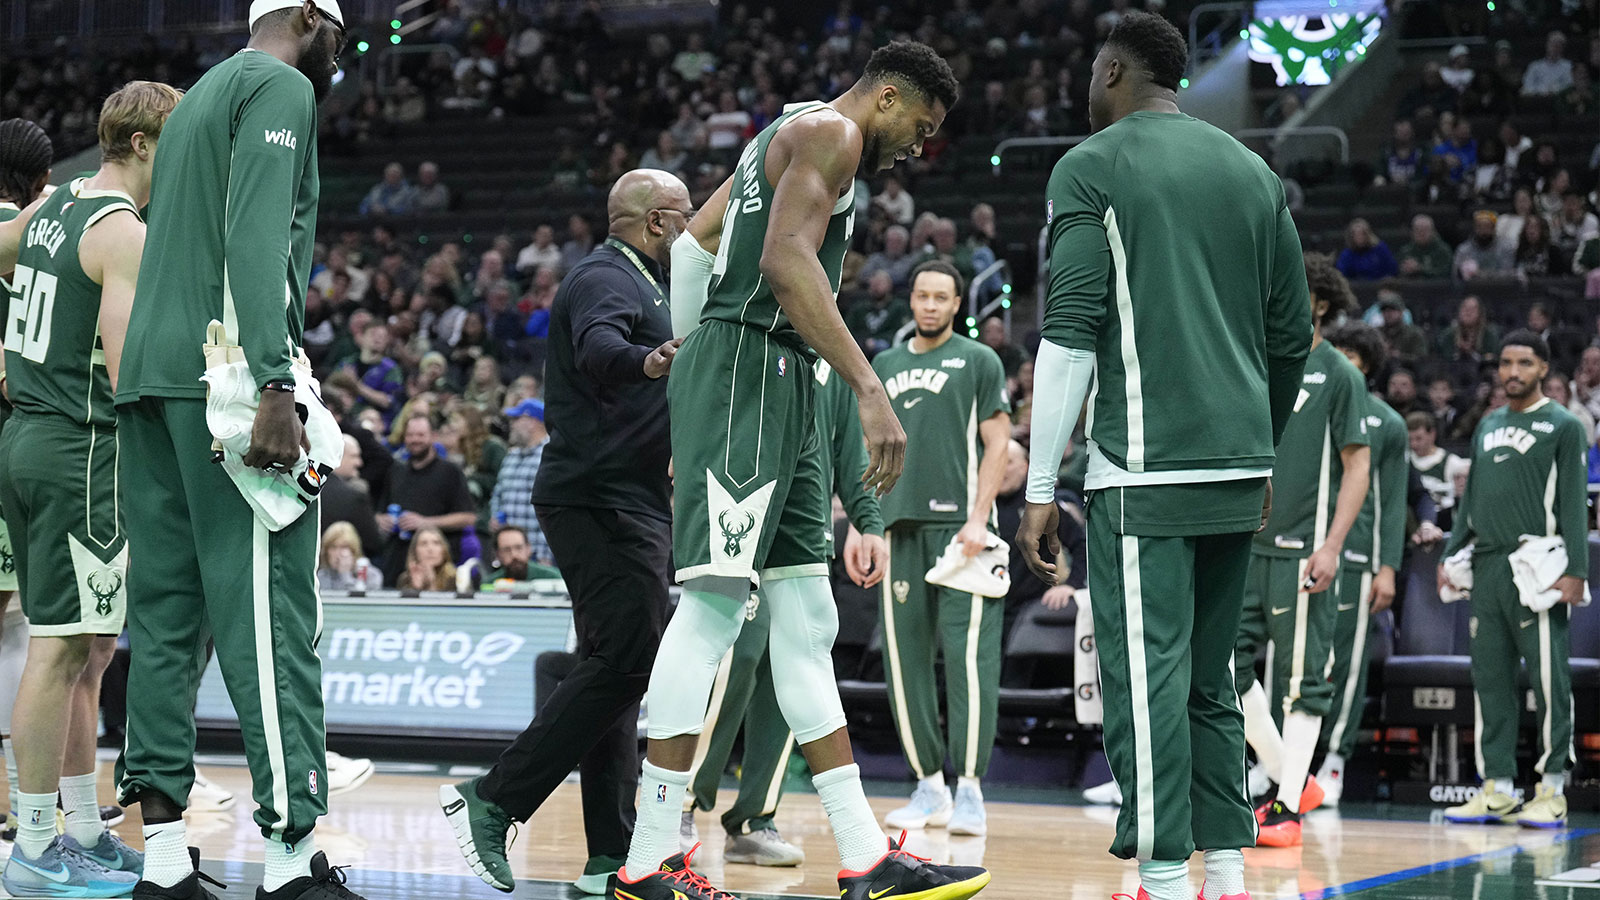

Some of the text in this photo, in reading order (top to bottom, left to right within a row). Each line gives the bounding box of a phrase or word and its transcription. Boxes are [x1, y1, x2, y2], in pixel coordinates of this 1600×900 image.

[264, 128, 297, 150] wilo
[27, 218, 67, 258] GREEN
[3, 263, 59, 364] 20
[885, 368, 950, 400] BUCKS
[1483, 425, 1538, 455] BUCKS
[327, 622, 473, 664] metro
[1080, 635, 1094, 653] G
[322, 665, 487, 709] market
[1078, 683, 1094, 701] G
